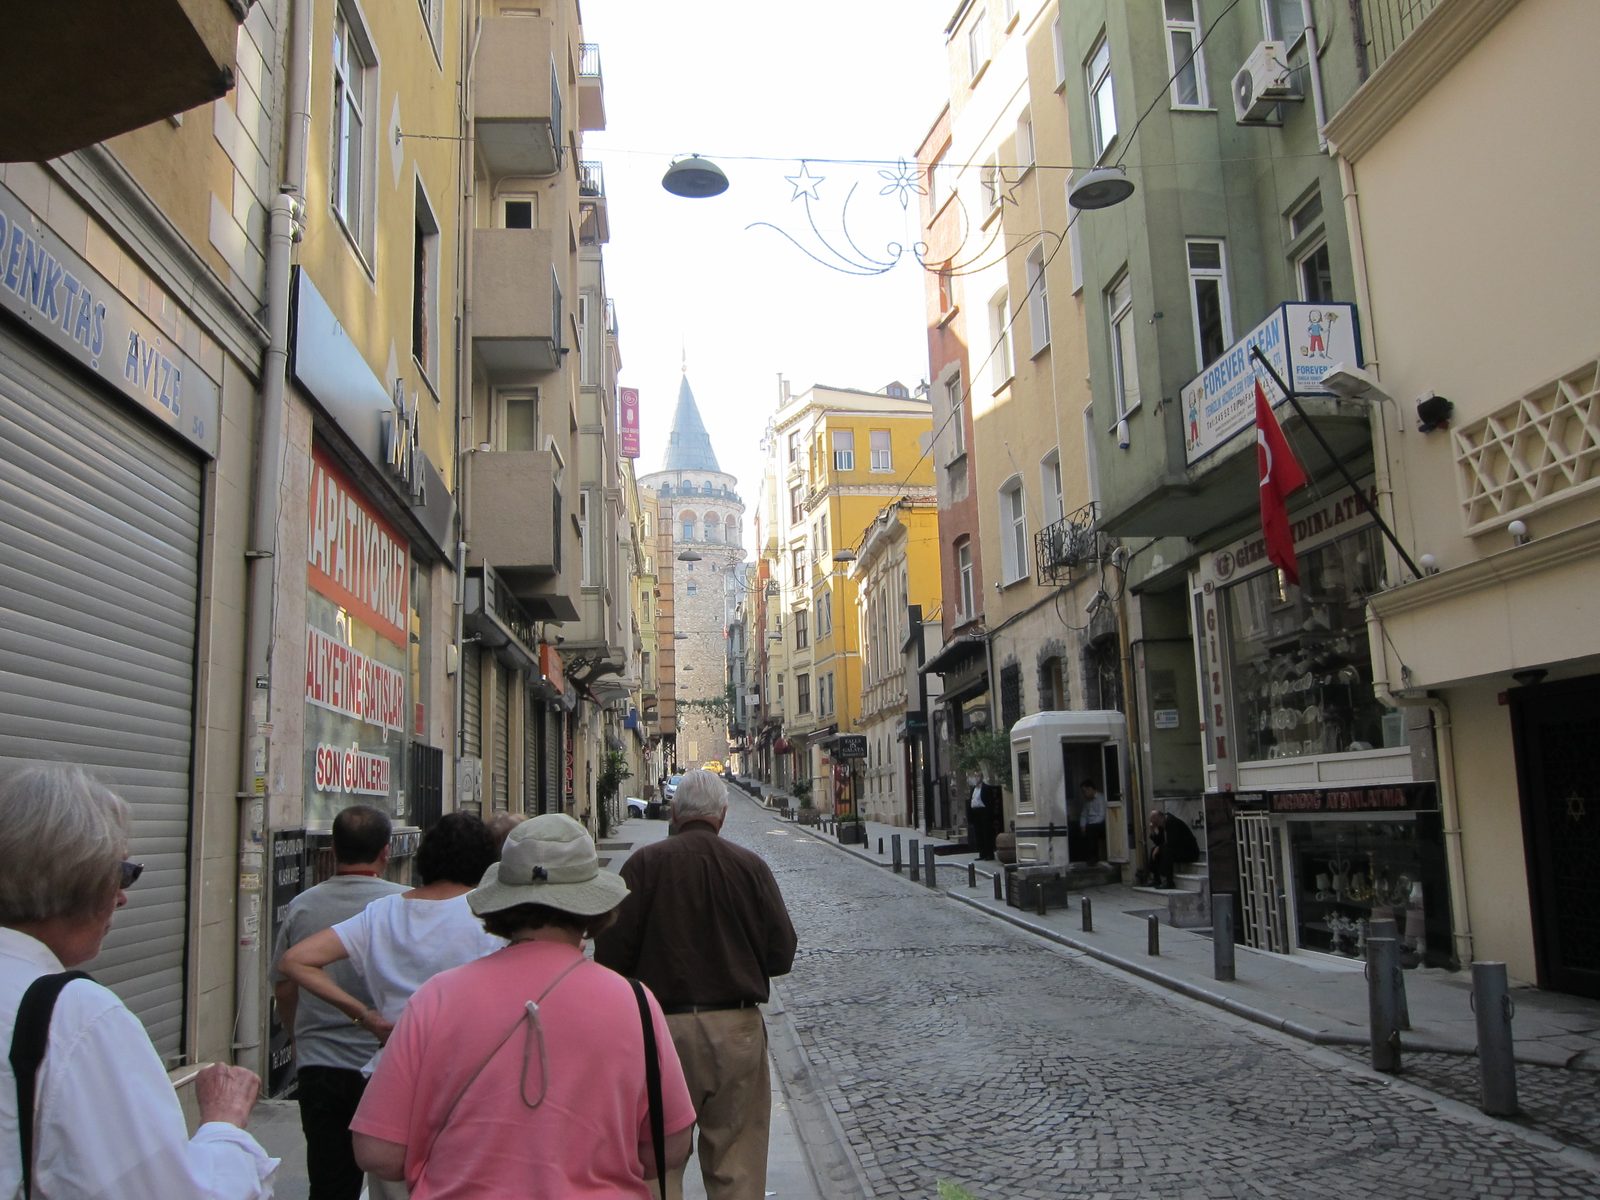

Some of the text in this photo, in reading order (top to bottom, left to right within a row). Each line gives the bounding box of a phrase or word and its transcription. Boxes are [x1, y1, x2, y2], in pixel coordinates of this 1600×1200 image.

[124, 328, 181, 418] AVİZE
[1203, 347, 1245, 400] FOREVER
[1296, 365, 1328, 375] FOREVER
[1291, 485, 1379, 545] YDINLATMA
[1235, 538, 1267, 569] GİZE
[306, 629, 404, 740] ALİYETİNE SATIŞLAR
[316, 746, 390, 792] SON GÜNLER!!!
